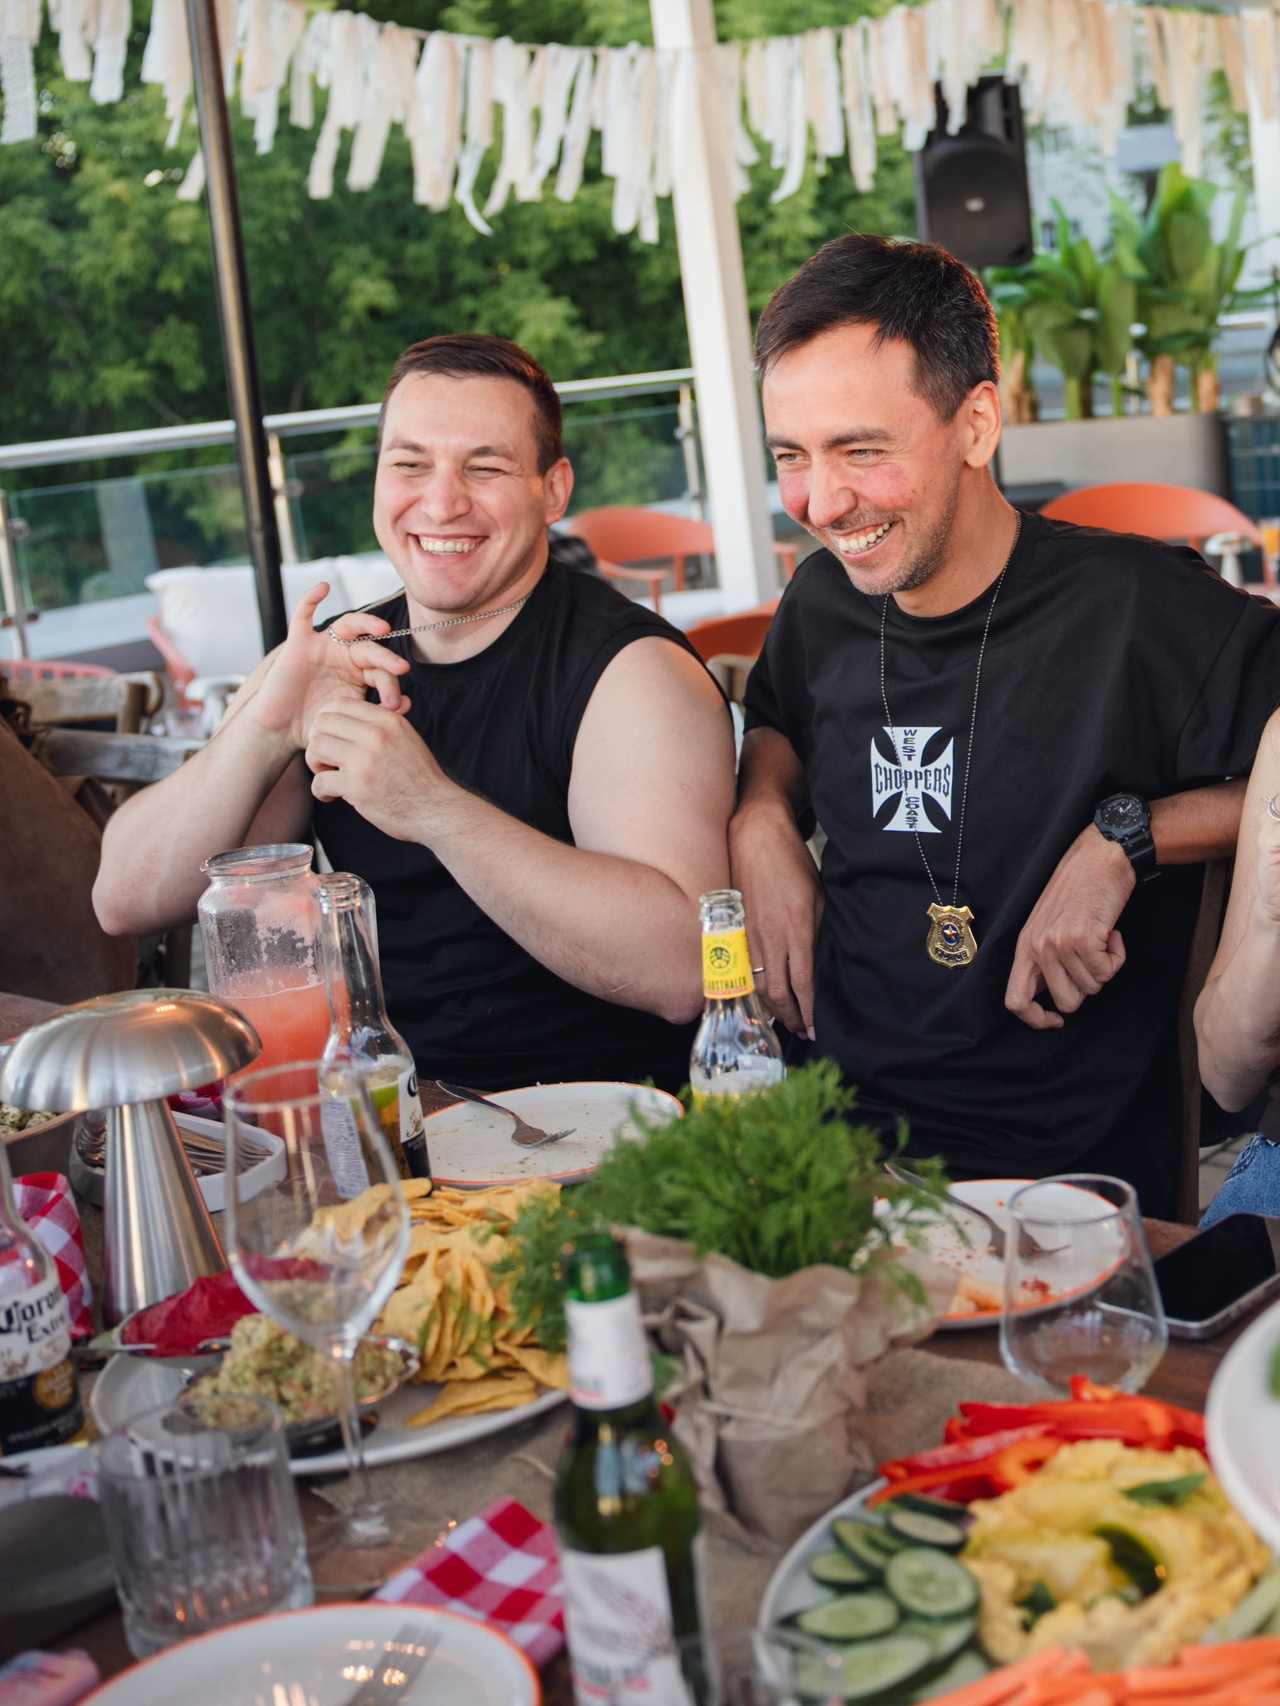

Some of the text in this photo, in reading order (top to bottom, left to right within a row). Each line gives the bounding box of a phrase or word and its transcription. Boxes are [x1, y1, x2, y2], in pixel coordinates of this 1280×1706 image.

[902, 729, 918, 762] WEST
[873, 762, 952, 798] CHOPPERS
[904, 796, 920, 829] COAST
